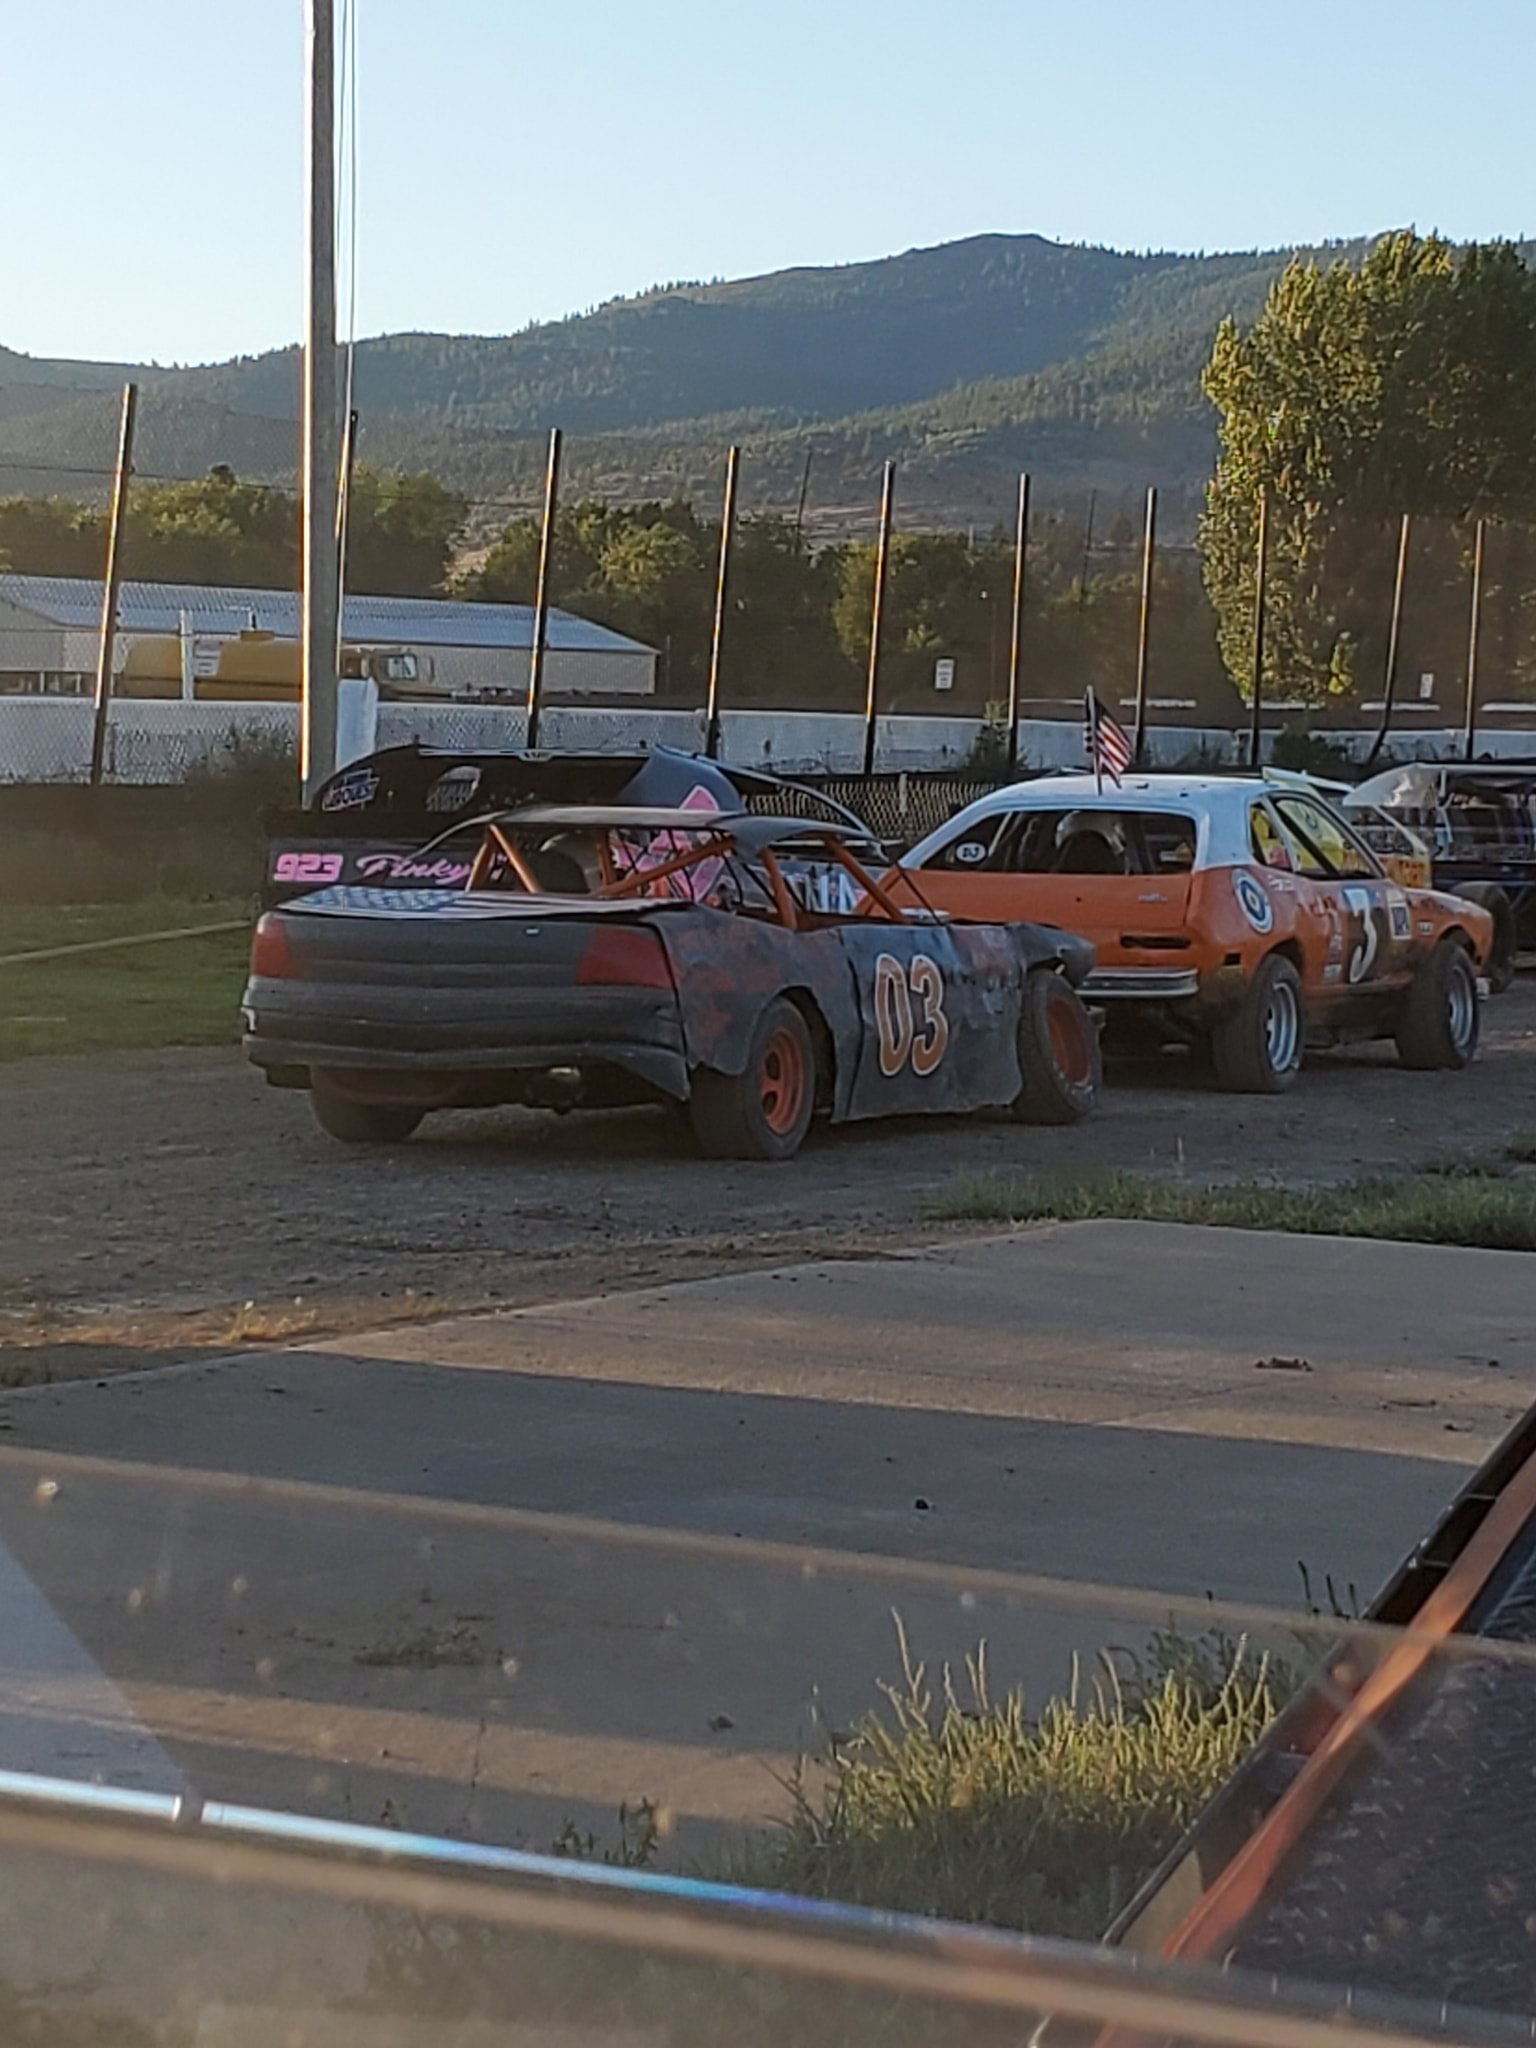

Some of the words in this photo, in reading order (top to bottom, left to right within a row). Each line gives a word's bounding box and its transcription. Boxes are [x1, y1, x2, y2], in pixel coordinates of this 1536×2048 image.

[274, 854, 343, 881] 923
[356, 854, 470, 885] Pinky
[874, 952, 949, 1076] 03
